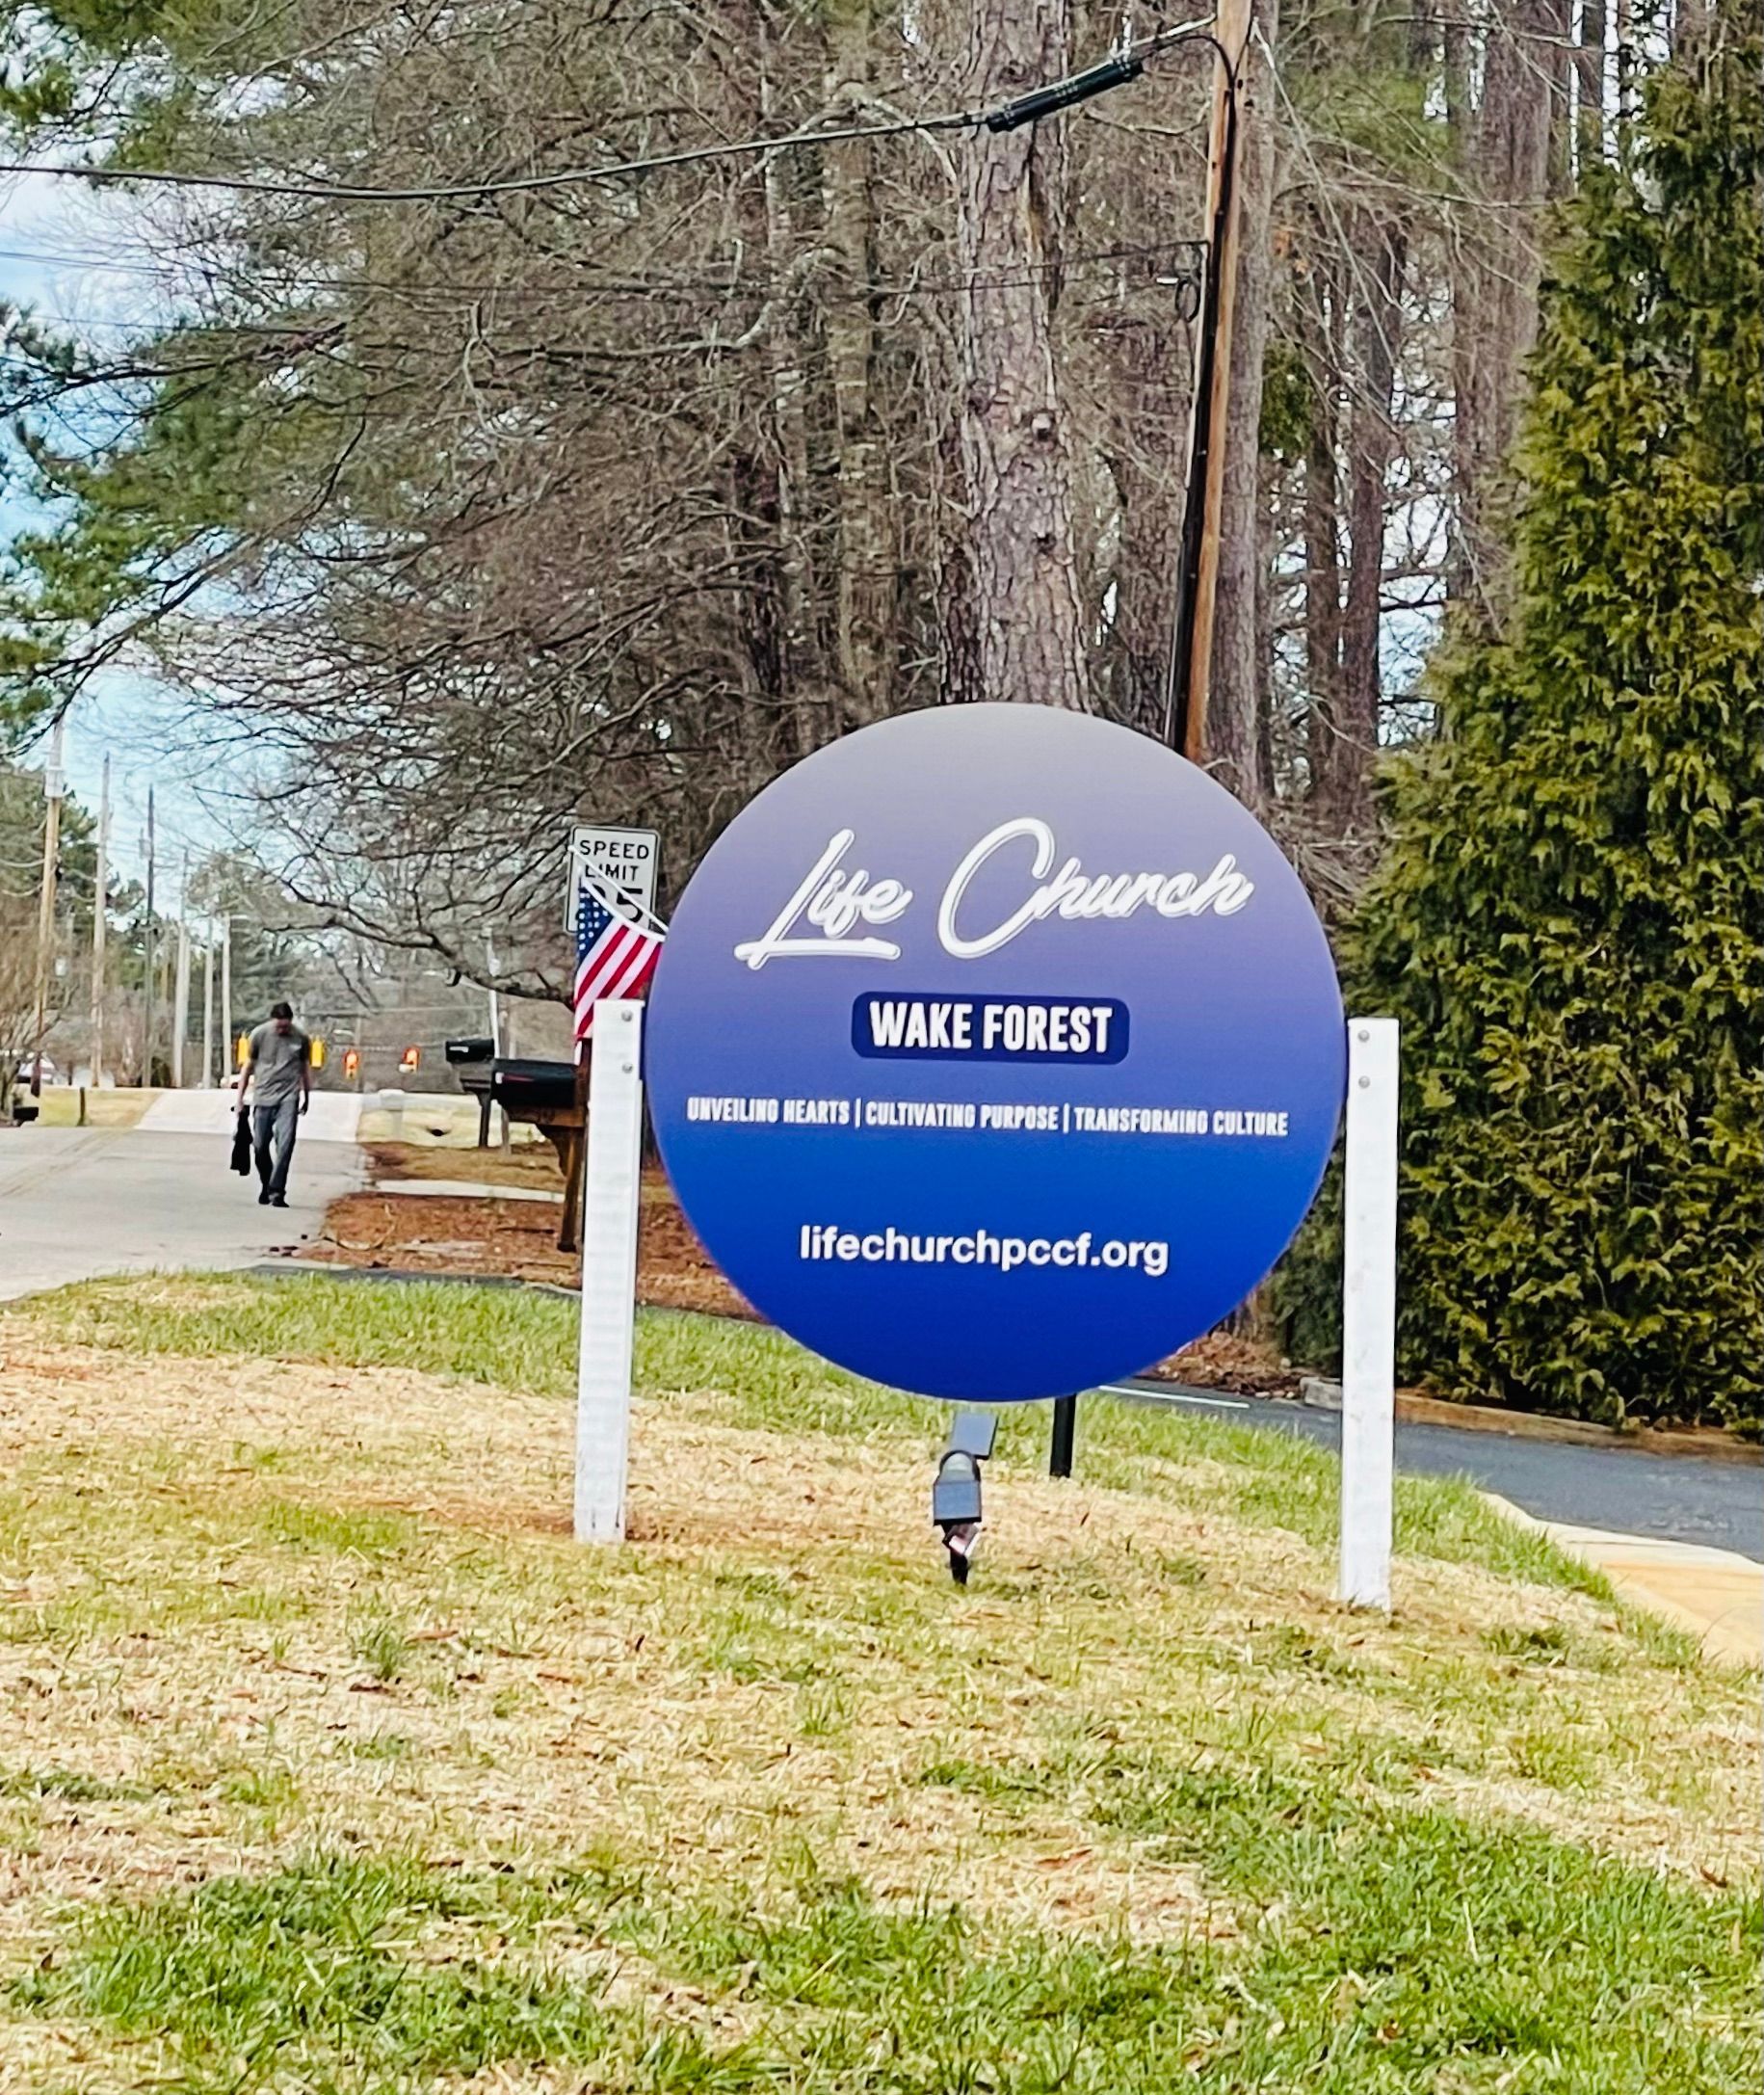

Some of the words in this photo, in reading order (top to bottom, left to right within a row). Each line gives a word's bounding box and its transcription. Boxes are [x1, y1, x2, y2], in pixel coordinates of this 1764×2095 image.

[580, 839, 648, 860] SPEED
[734, 829, 913, 969] Life
[938, 817, 1254, 959] Church
[869, 1001, 973, 1048] WAKE
[983, 1004, 1113, 1053] FOREST
[687, 1097, 779, 1124] UNVEILING
[782, 1100, 851, 1126] HEARTS
[866, 1101, 976, 1128] CULTIVATING
[980, 1104, 1059, 1131] PURPOSE
[1074, 1107, 1209, 1134] TRANSFORMING
[1212, 1110, 1289, 1137] CULTURE
[799, 1225, 1170, 1277] lifechurchpccf.org
